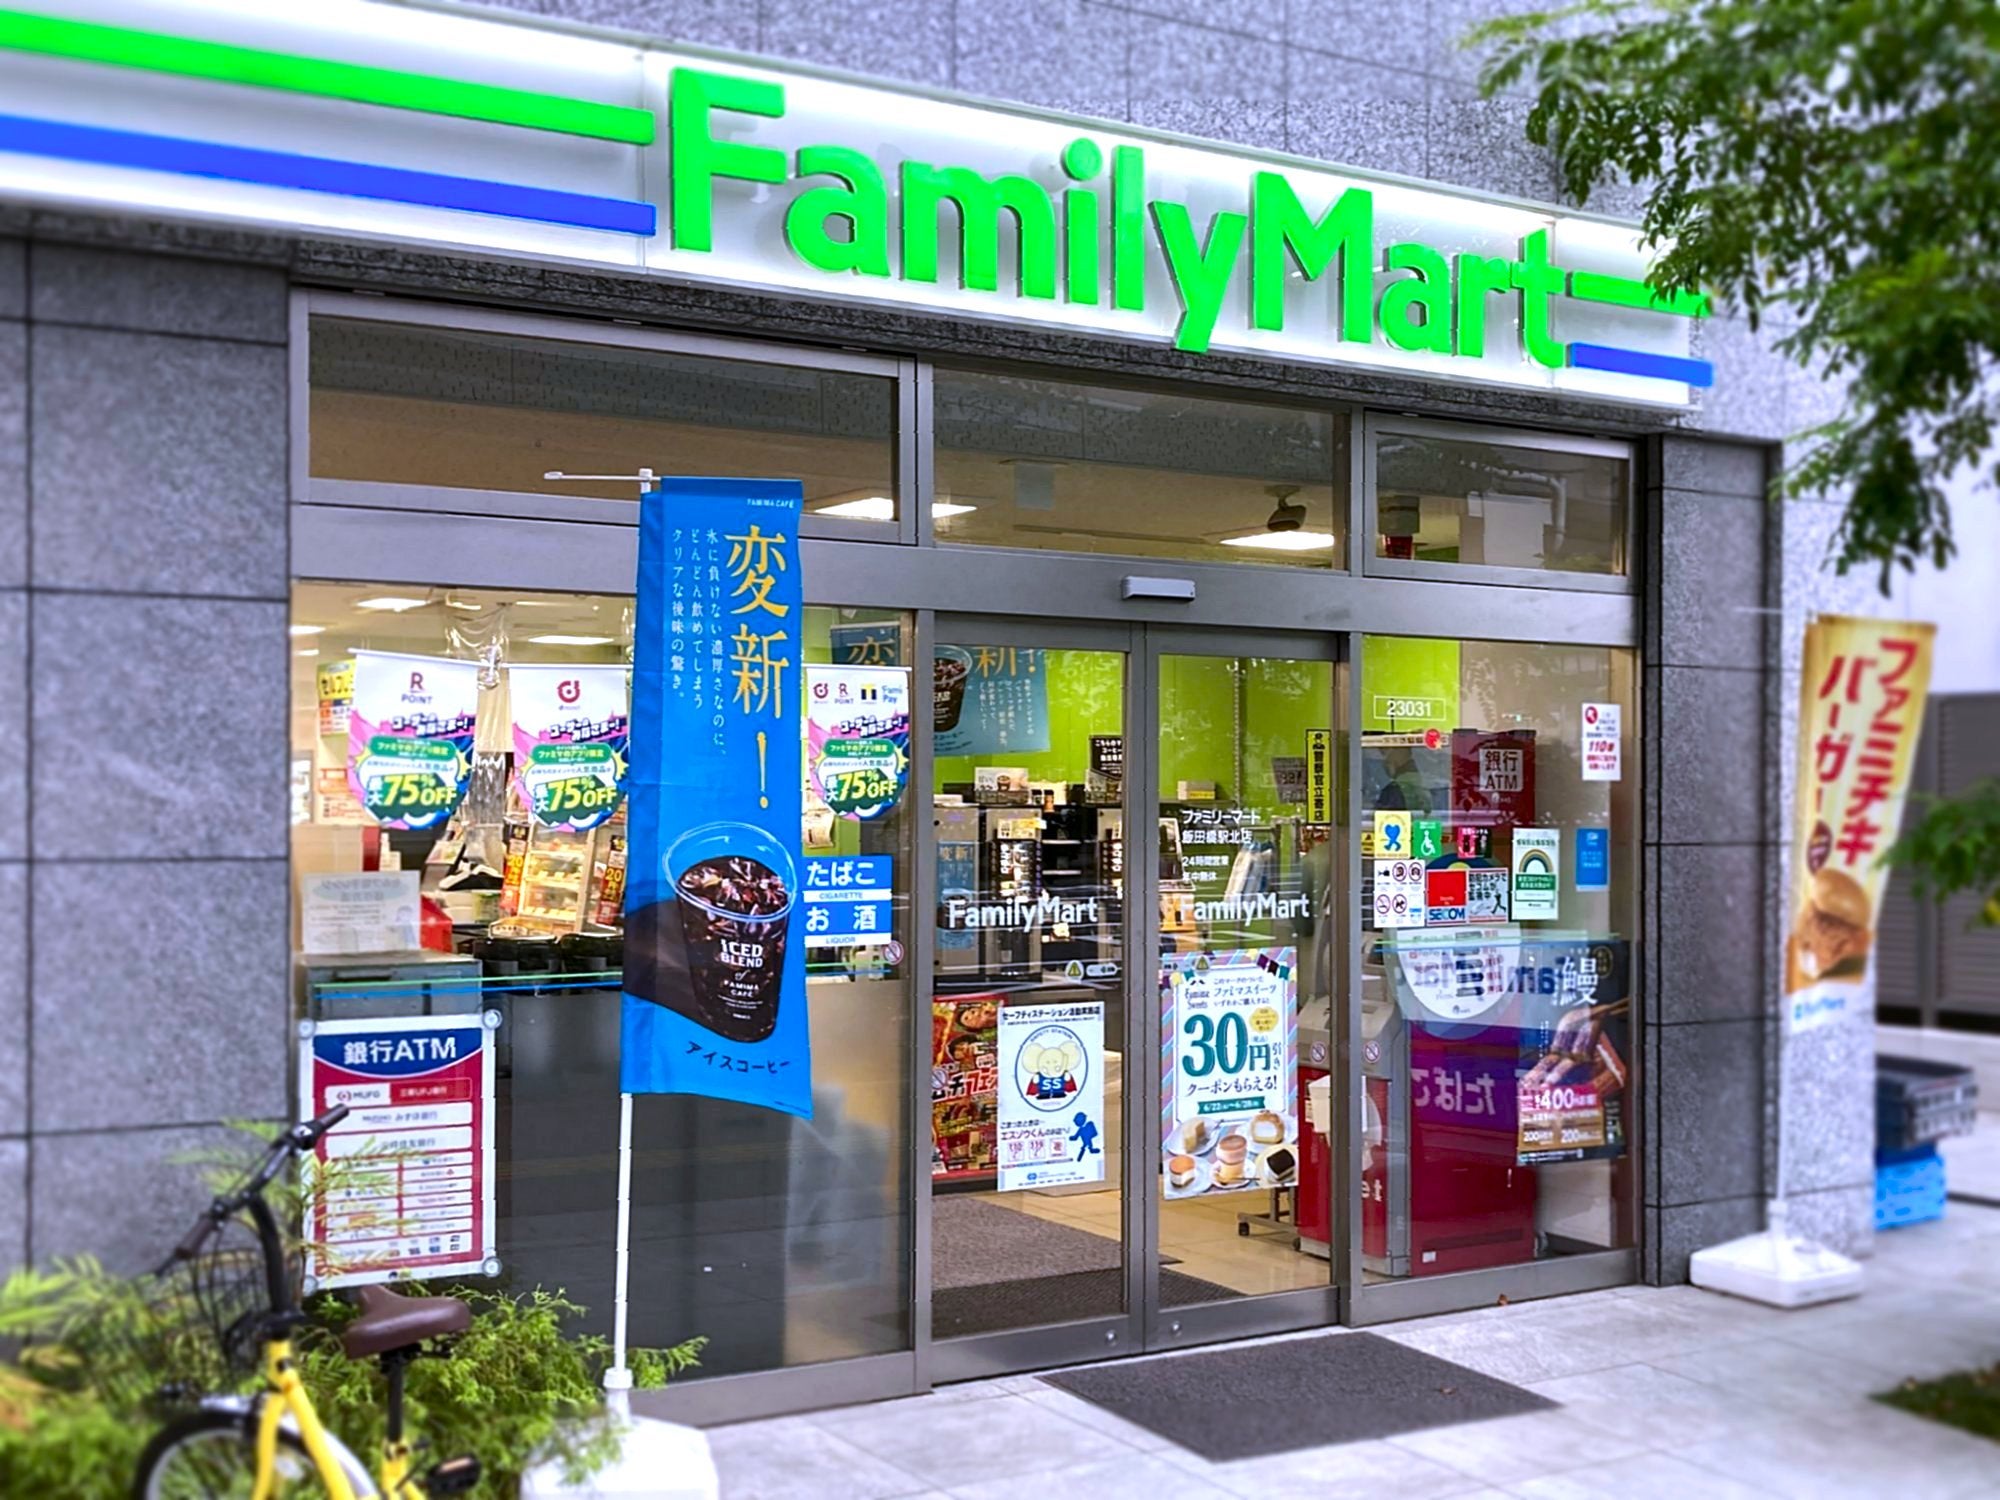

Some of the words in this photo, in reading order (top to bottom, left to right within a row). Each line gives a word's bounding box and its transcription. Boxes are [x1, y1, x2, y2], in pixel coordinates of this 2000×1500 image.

[669, 67, 1566, 368] FamilyMart
[411, 672, 423, 690] R
[1387, 700, 1432, 717] 23031
[1815, 655, 1878, 816] バーガー
[1484, 750, 1519, 773] 銀行
[1835, 636, 1918, 867] ファミチキ
[1485, 774, 1518, 791] ATM
[1181, 810, 1261, 824] ファミリーマート
[807, 860, 876, 887] たばこ
[948, 896, 1099, 933] FamilyMart
[1181, 893, 1310, 927] FamilyMart
[1428, 908, 1466, 920] SECOM
[720, 939, 764, 957] ICED
[720, 952, 764, 968] BLEND
[1213, 984, 1278, 998] ファミマスイーツ
[344, 1036, 456, 1065] 銀行ATM
[686, 1040, 790, 1075] アイスコーヒー
[1042, 1078, 1062, 1090] SS
[1185, 1074, 1278, 1097] クーポンもらえる!
[352, 1091, 381, 1101] MUFG
